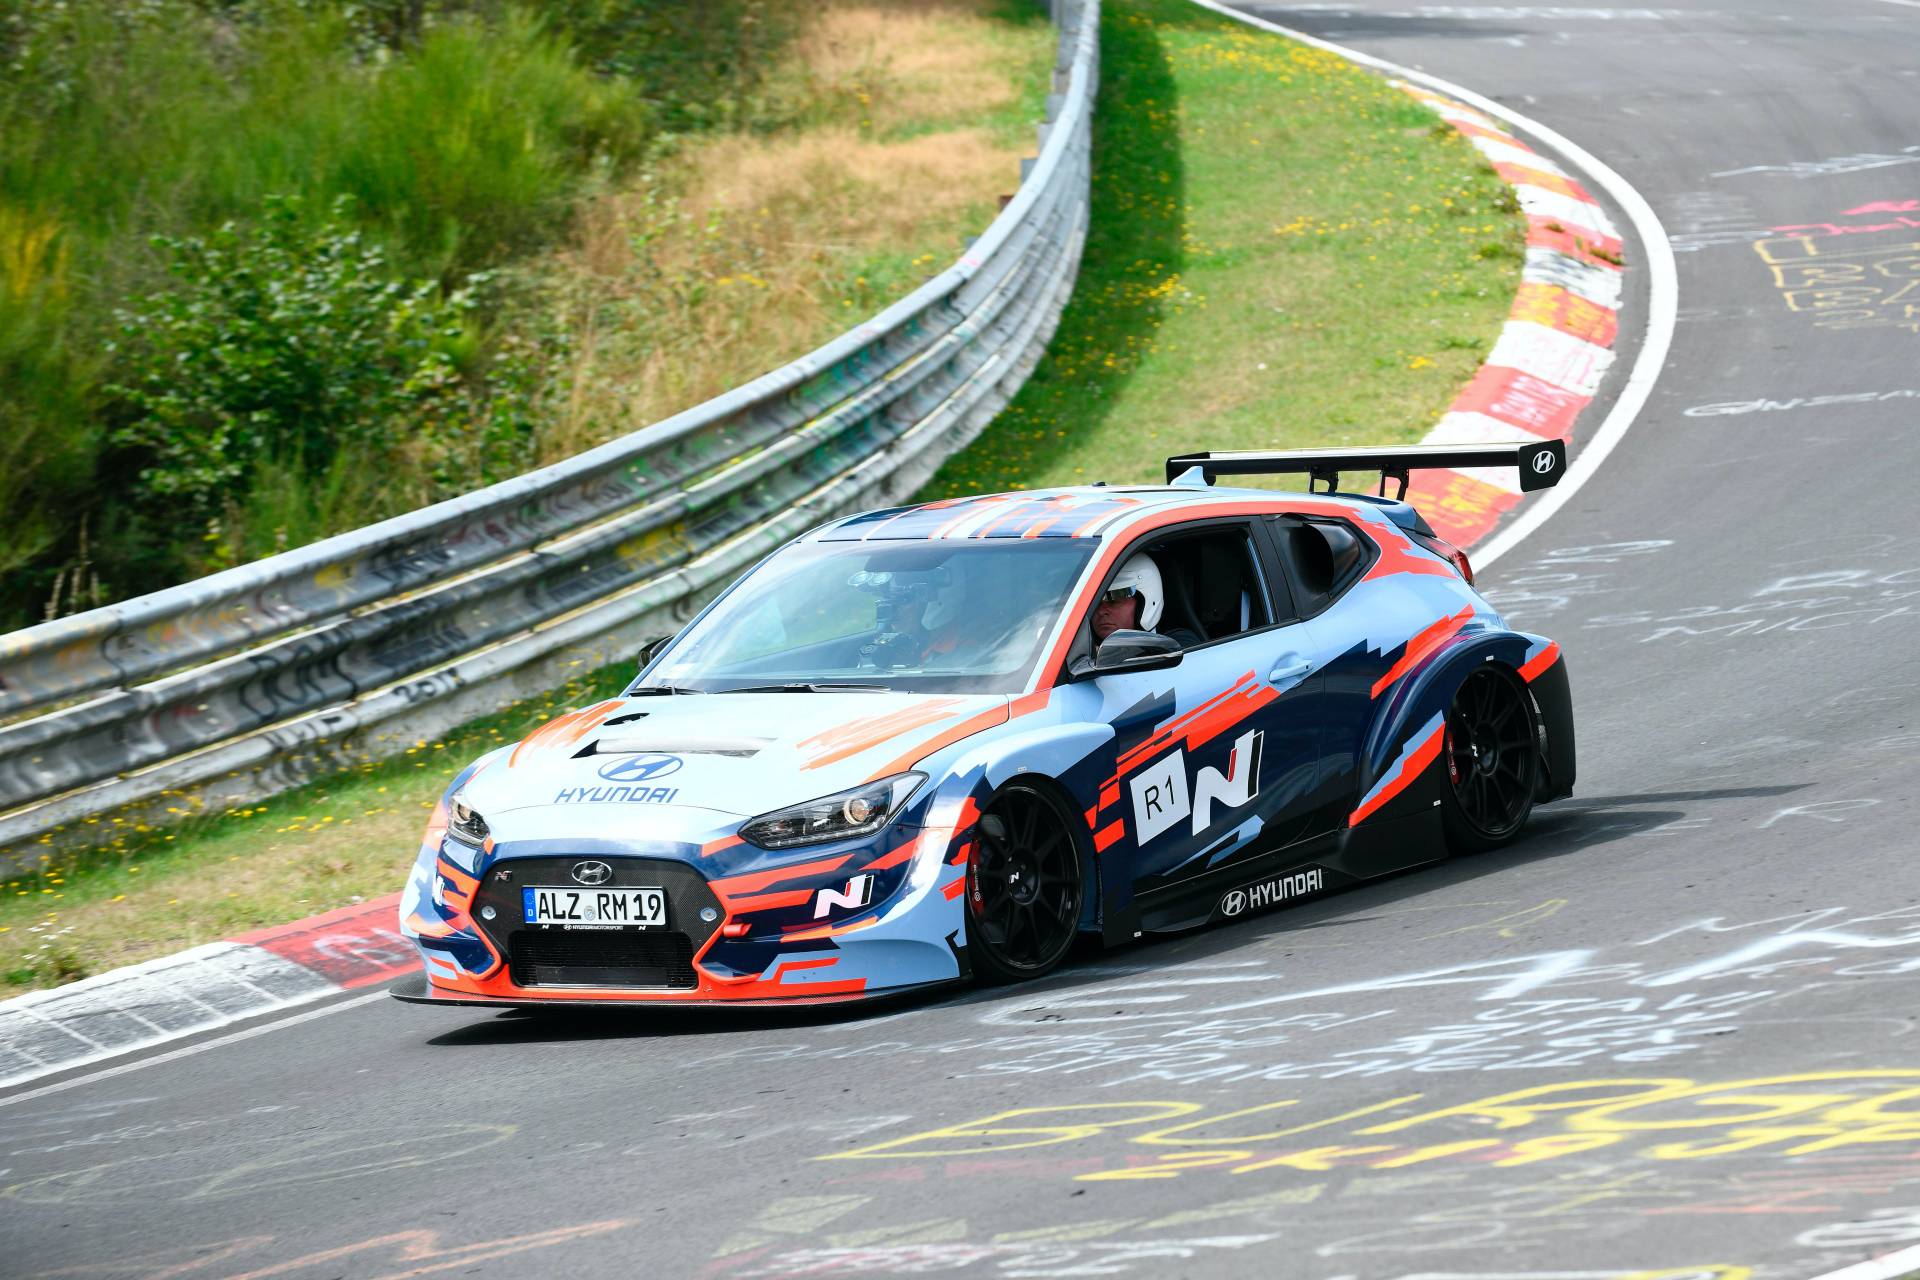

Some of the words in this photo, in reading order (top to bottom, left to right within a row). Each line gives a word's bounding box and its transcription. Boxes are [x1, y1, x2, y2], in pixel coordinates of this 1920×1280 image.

[553, 787, 679, 803] HYUNDAI
[1144, 775, 1175, 820] R1
[539, 893, 581, 919] ALZ
[597, 894, 627, 920] RM
[633, 894, 661, 920] 19
[1250, 869, 1322, 908] HYUNDAI
[1074, 1130, 1628, 1181] 2K19
